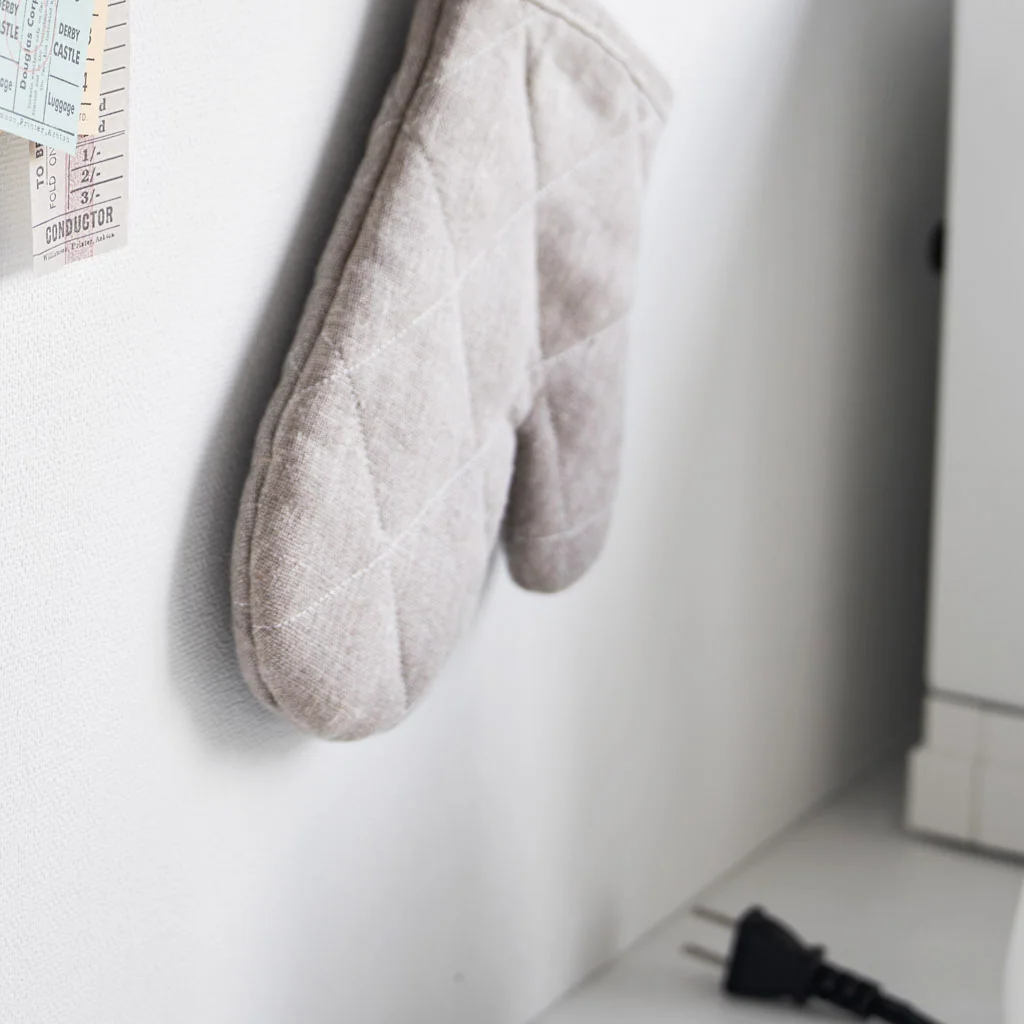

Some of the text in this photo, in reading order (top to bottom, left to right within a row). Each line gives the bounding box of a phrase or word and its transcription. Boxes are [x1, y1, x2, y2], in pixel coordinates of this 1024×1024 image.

[58, 22, 80, 42] DERBY
[19, 32, 33, 90] Douglas
[53, 41, 81, 65] CASTLE
[47, 92, 75, 116] Luggage
[36, 166, 44, 190] TO
[45, 206, 113, 245] CONDUCTOR
